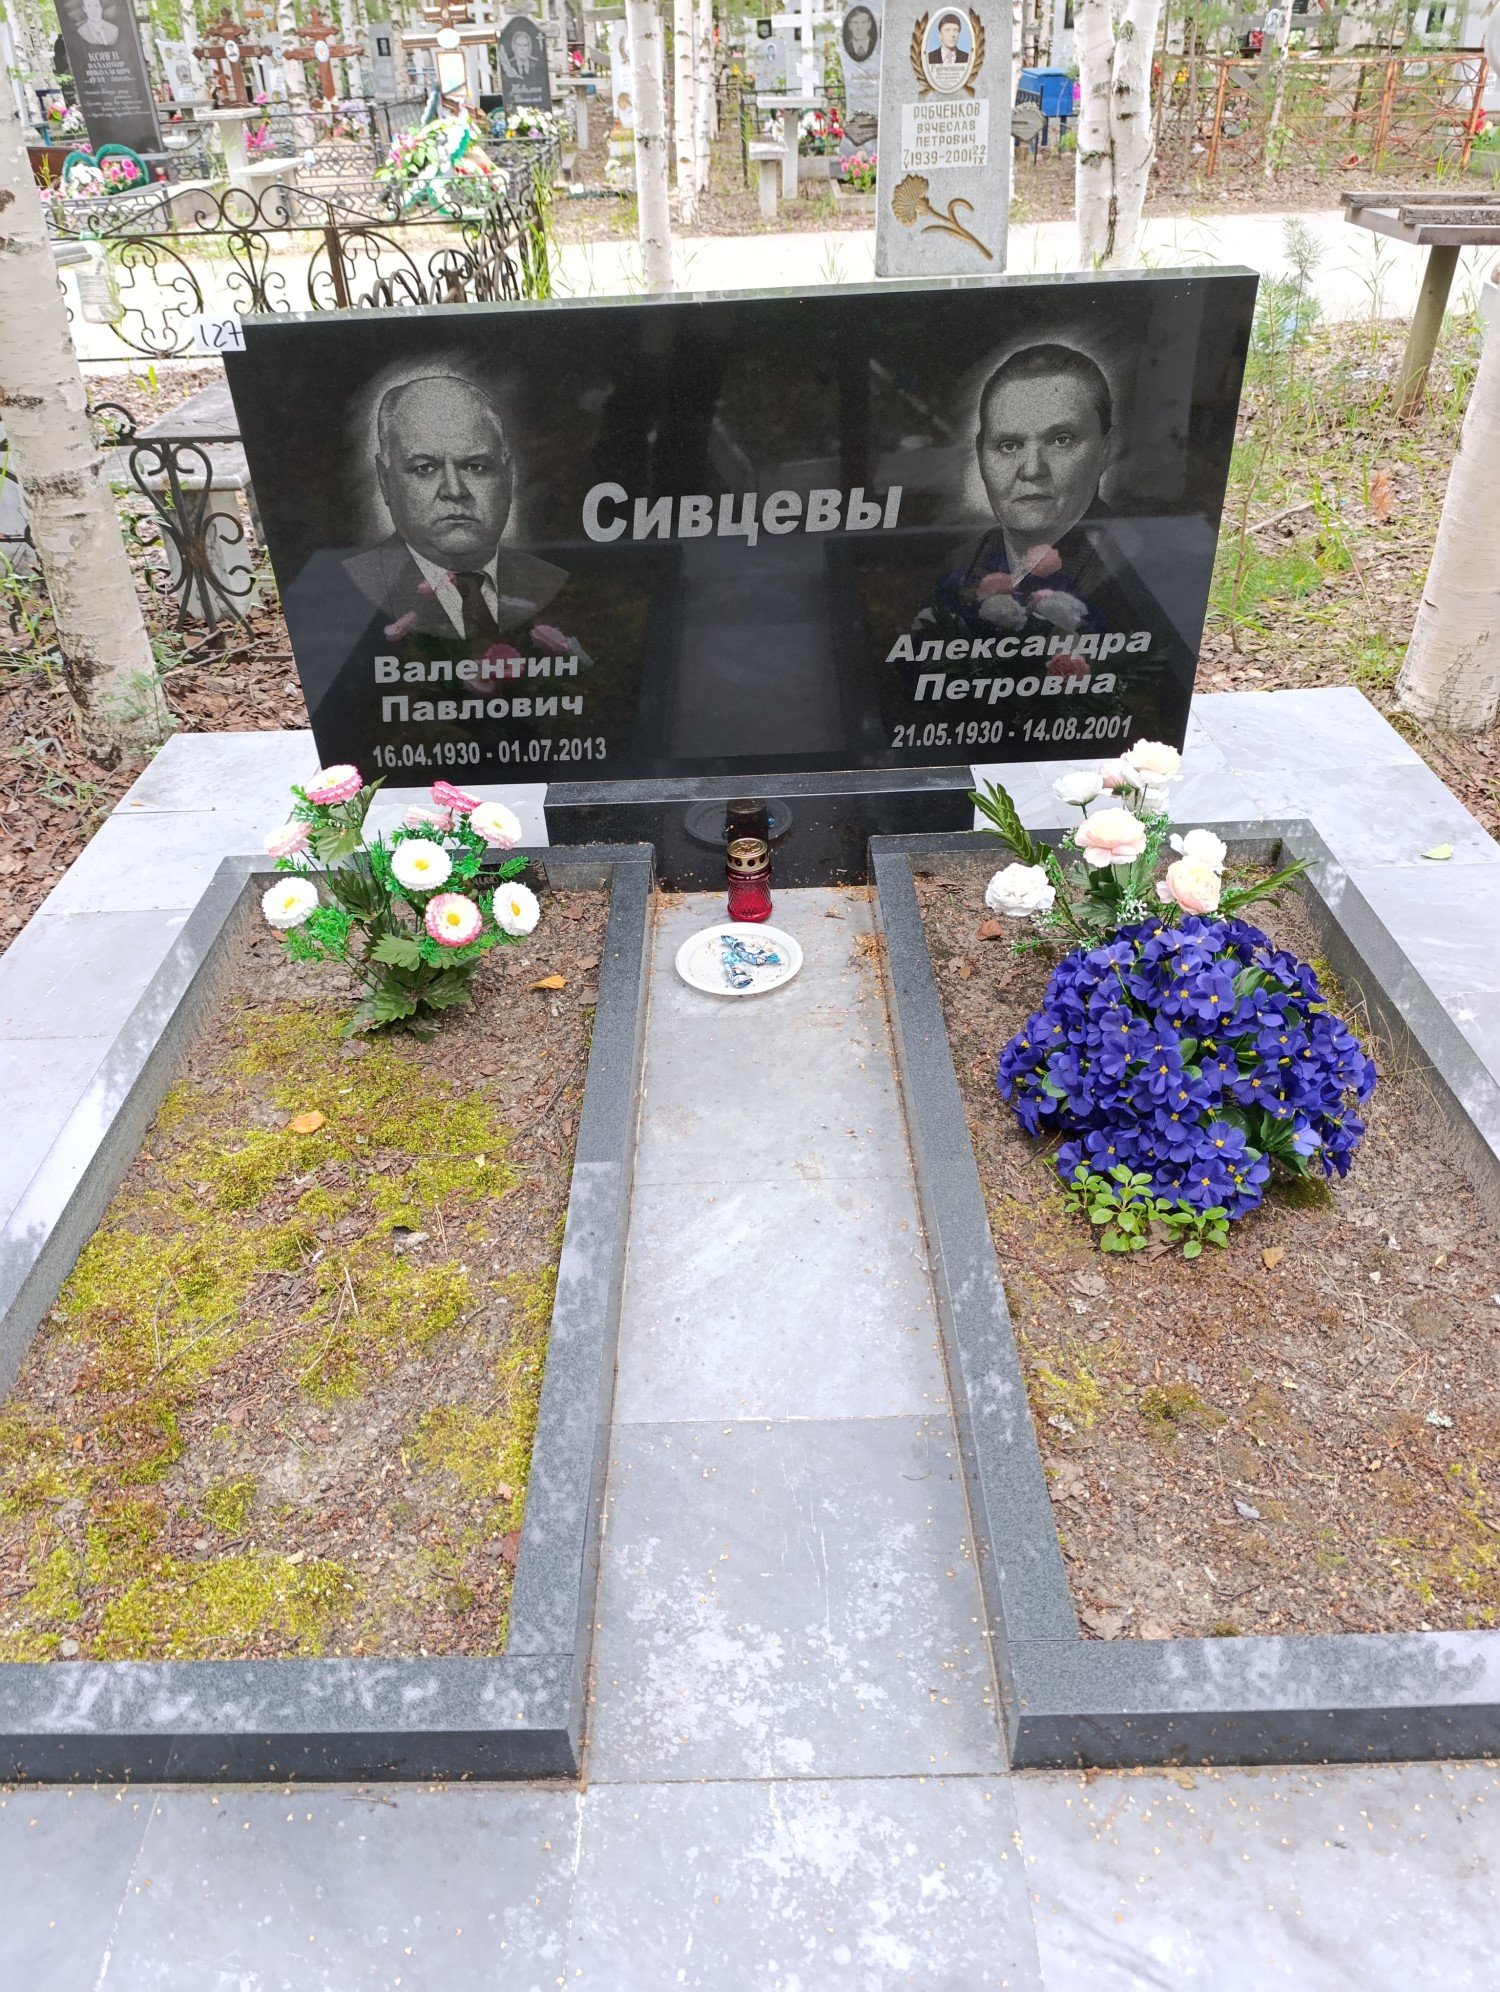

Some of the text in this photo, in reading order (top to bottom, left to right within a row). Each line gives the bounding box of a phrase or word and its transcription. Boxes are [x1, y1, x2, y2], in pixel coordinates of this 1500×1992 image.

[913, 102, 981, 120] РЯБЧЕНКОВ
[916, 120, 976, 134] ВЯЧЕСЛАВ
[916, 133, 976, 148] ПЕТРОВИЧ
[200, 319, 243, 348] 127
[582, 481, 903, 547] Сивцевы
[885, 631, 1152, 663] Александра
[374, 655, 579, 684] Валентин
[914, 672, 1117, 705] Петровна
[382, 695, 584, 723] Павлович
[891, 720, 1004, 748] 21.05.1930
[1022, 715, 1133, 742] 14.08.2001
[373, 741, 481, 768] 16.04.1930
[498, 736, 607, 764] 01.07.2013
